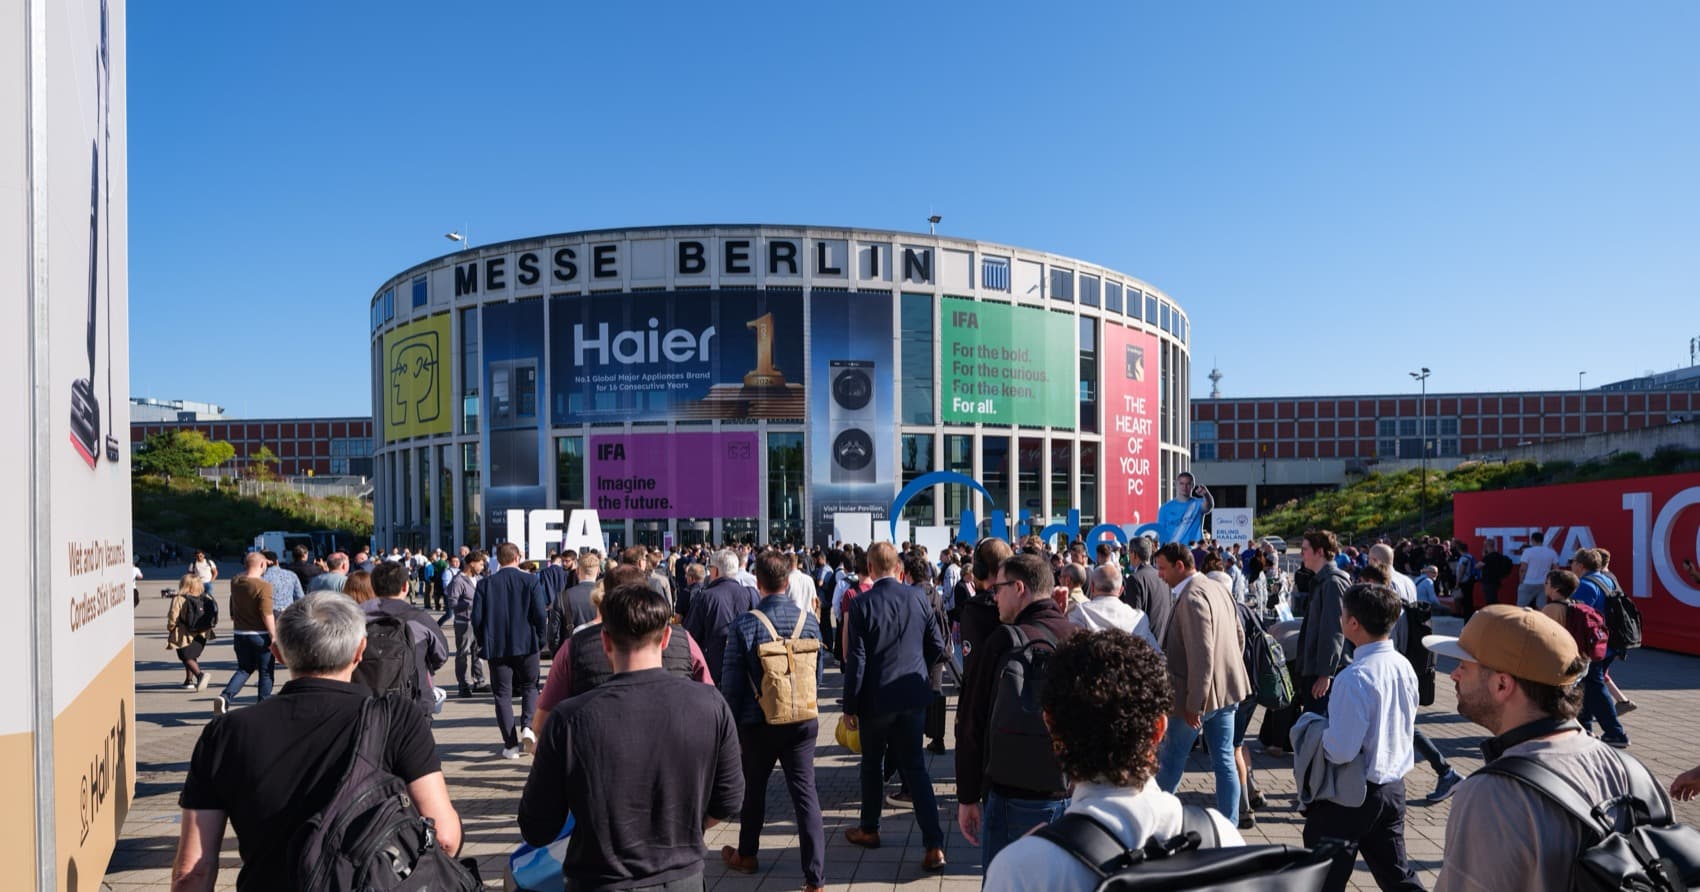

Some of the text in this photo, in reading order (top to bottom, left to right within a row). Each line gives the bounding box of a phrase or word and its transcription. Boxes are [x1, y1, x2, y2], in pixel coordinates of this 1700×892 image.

[455, 240, 930, 297] MESSE BERLIN
[952, 311, 979, 329] IFA
[573, 316, 716, 366] Haier
[952, 342, 1032, 362] For the bold.
[575, 371, 711, 384] No.1 Global Major Appliances Brand
[952, 361, 1049, 383] For the curious.
[596, 384, 607, 392] for
[619, 382, 665, 391] Consecutive
[667, 381, 689, 390] Years
[952, 379, 1035, 399] For the keen.
[952, 398, 997, 415] For all.
[1123, 394, 1146, 415] THE
[1115, 416, 1152, 434] HEART
[597, 443, 625, 461] IFA
[1128, 436, 1143, 452] OF
[1119, 458, 1150, 476] YOUR
[597, 475, 656, 493] Imagine
[1128, 480, 1143, 495] PC
[597, 495, 673, 510] the future.
[823, 504, 838, 512] Visit
[839, 504, 856, 512] Haier
[507, 509, 607, 561] IFA
[68, 541, 83, 576] Wet
[84, 540, 94, 574] and
[95, 539, 104, 577] Dry
[105, 539, 122, 568] Vacuums
[70, 582, 126, 632] Cordless Stick Vacuums
[90, 735, 109, 824] Hall
